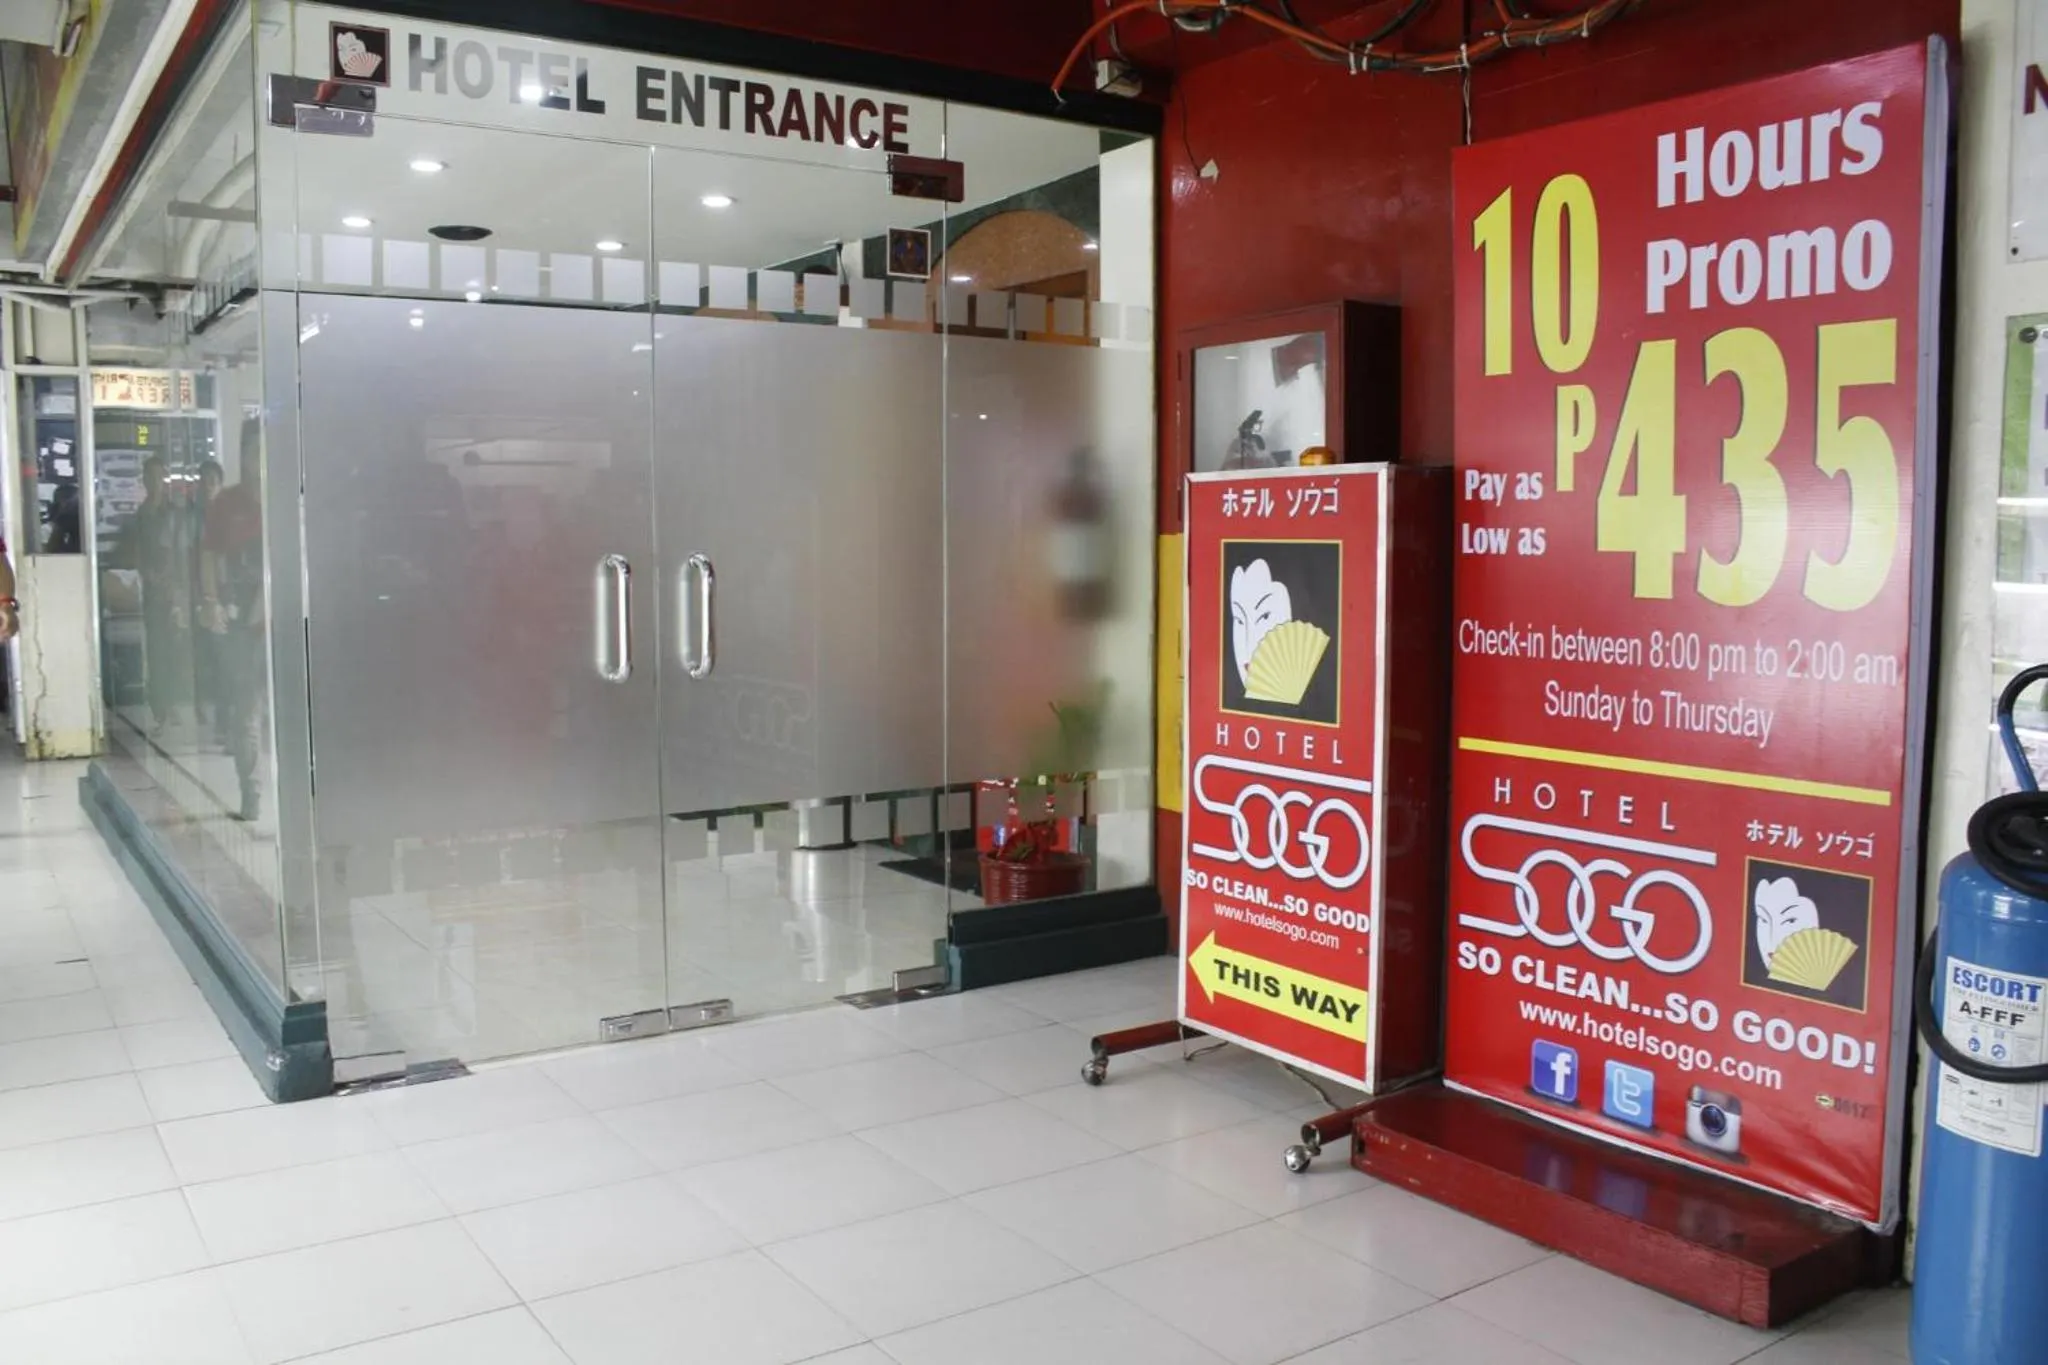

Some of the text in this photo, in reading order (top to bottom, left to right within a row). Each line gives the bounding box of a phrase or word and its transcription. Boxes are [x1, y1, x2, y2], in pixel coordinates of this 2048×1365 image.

[408, 33, 910, 154] HOTEL ENTRANCE
[1657, 101, 1884, 208] Hours
[1473, 174, 1599, 376] 10
[1646, 219, 1893, 314] Promo
[1222, 478, 1340, 518] ホテル ソウゴ
[1465, 469, 1543, 506] Pay as
[1462, 523, 1546, 556] Low as
[1458, 619, 1898, 686] Check-in between 8:00 pm to 2:00 am
[1216, 723, 1343, 764] HOTEL
[1544, 679, 1775, 748] Sunday to Thursday
[1192, 754, 1372, 889] SOGO
[1494, 777, 1676, 831] HOTEL
[1746, 819, 1876, 859] ホテル ソウゴ
[1187, 868, 1208, 889] SO
[1314, 902, 1370, 933] GOOD
[1459, 812, 1718, 974] SOGO
[1213, 902, 1340, 950] www.hotelsogo.com
[1213, 958, 1361, 1023] THIS WAY
[1458, 941, 1502, 976] SO
[1733, 1009, 1876, 1074] GOOD!
[1952, 966, 2043, 1003] ESCORT
[1959, 1000, 2026, 1027] A-FFF
[1519, 1000, 1783, 1090] www.hotelsogo.com
